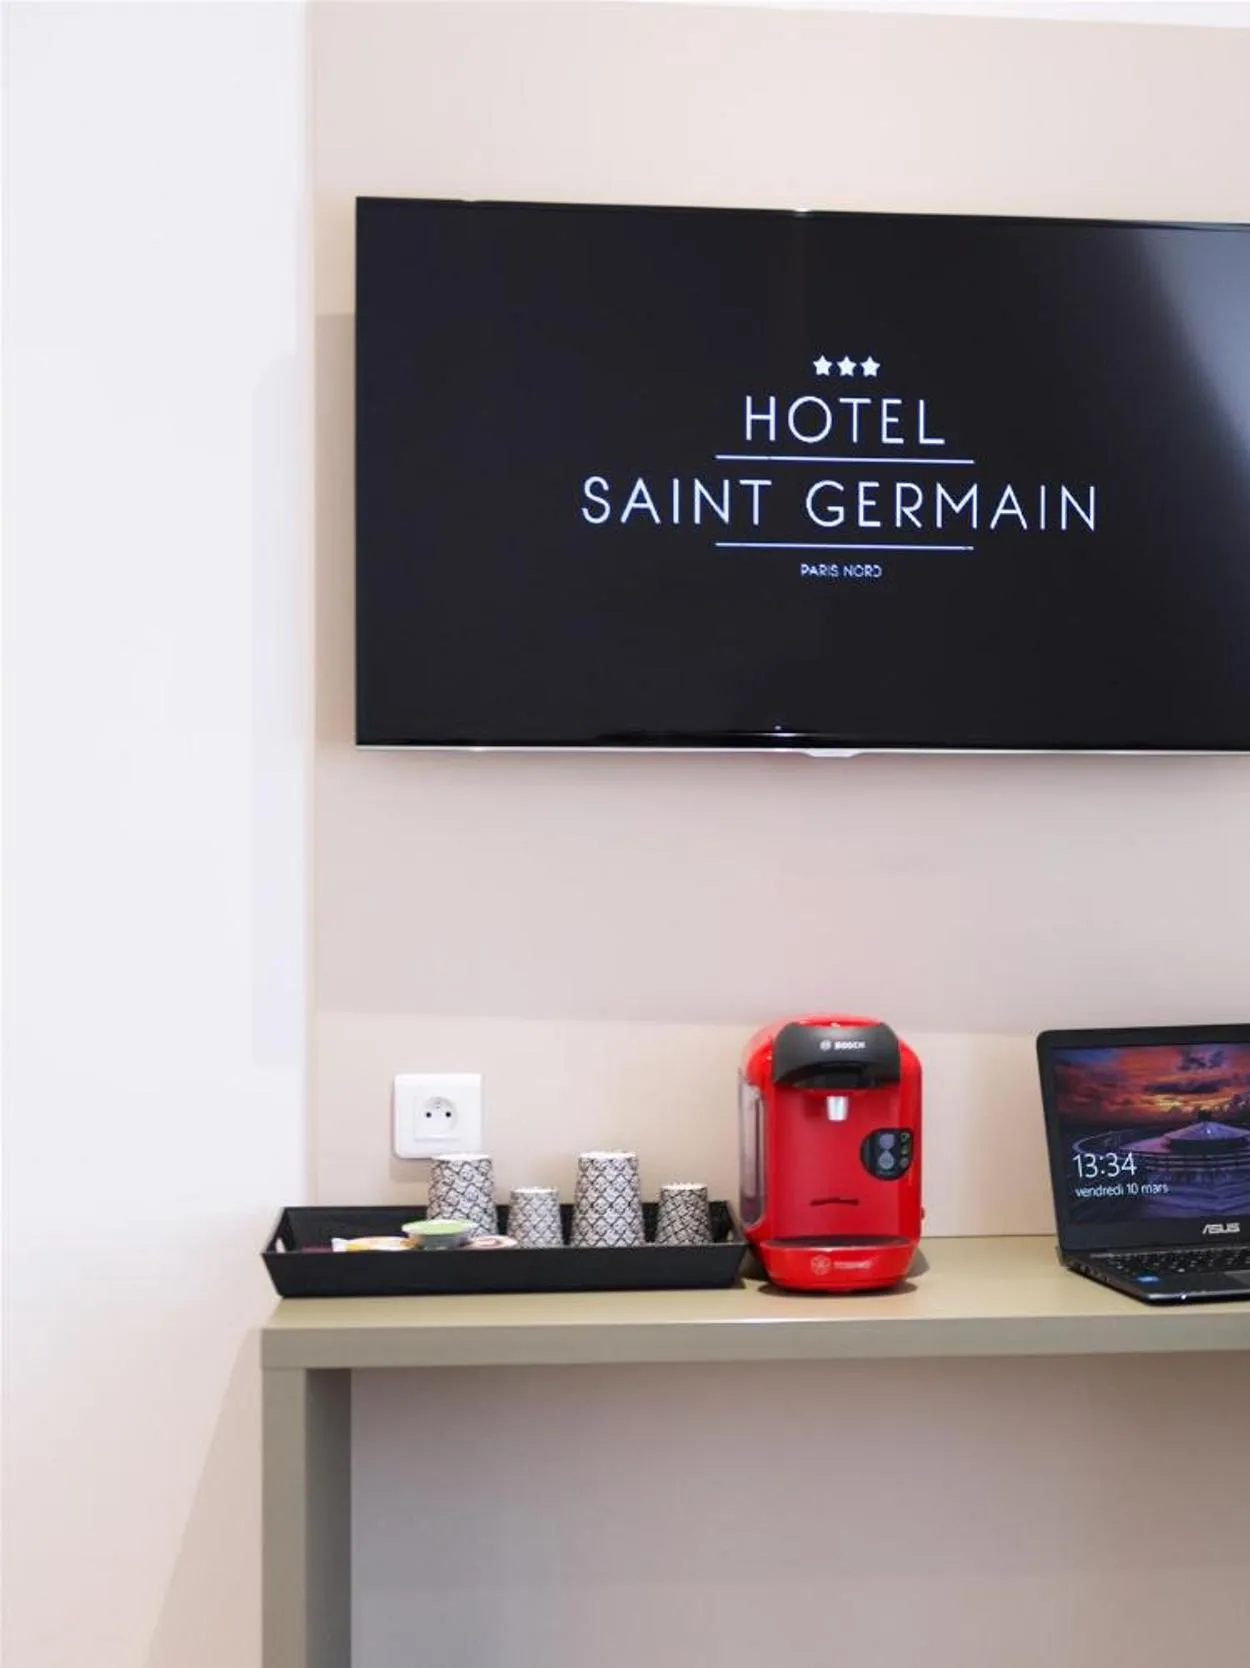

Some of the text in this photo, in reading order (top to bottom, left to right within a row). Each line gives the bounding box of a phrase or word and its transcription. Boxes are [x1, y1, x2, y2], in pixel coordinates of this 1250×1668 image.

[745, 395, 946, 445] HOTEL
[581, 475, 1097, 532] SAINT GERMAIN
[800, 563, 883, 578] PARIS NORD
[1072, 1151, 1138, 1179] 13:34
[1075, 1183, 1169, 1198] vendredi 10 mars
[1202, 1222, 1241, 1235] ASUS
